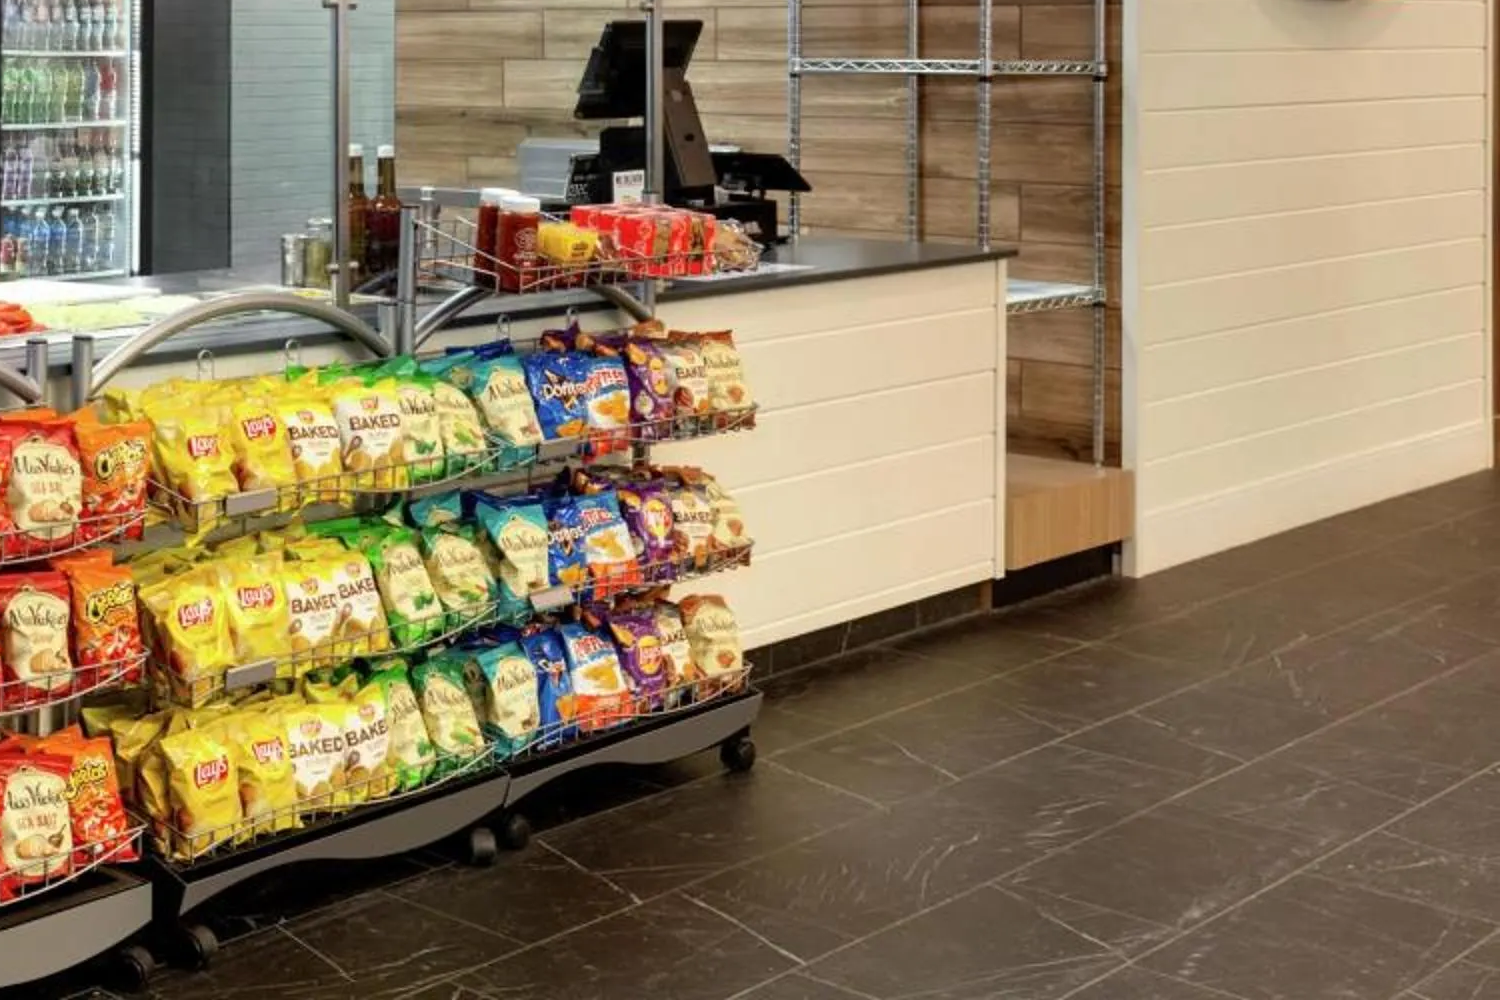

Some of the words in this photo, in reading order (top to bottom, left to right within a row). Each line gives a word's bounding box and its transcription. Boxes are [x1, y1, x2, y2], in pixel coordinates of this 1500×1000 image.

[350, 412, 400, 431] BAKED
[288, 425, 340, 441] BAKED
[338, 577, 374, 598] BAKE
[345, 719, 387, 747] BAKE
